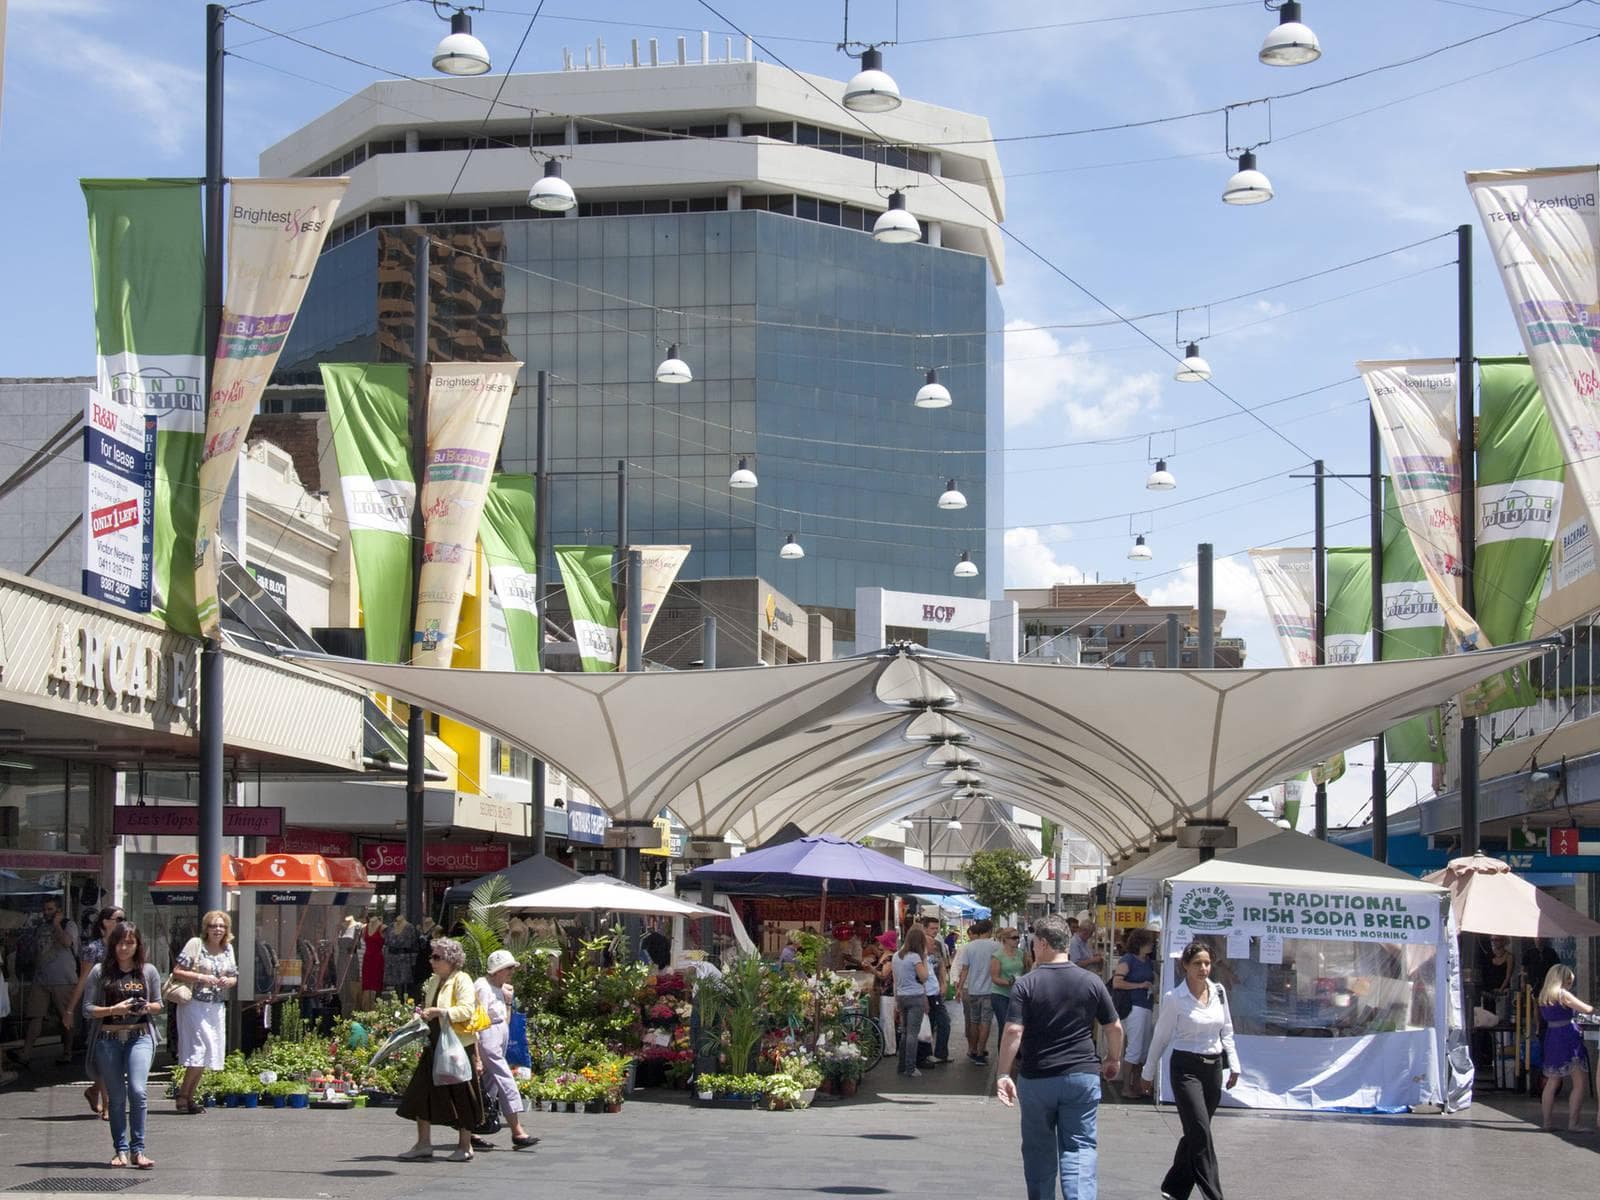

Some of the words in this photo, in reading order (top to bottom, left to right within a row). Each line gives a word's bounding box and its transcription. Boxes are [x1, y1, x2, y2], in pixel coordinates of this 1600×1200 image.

[233, 206, 291, 224] Brightest
[301, 220, 325, 232] BES
[112, 376, 200, 394] BONDI
[435, 377, 480, 391] Brightest
[93, 403, 118, 432] R&W
[100, 438, 112, 458] for
[113, 444, 135, 469] lease
[142, 434, 153, 526] RICHARDSON
[93, 514, 113, 532] ONLY
[112, 508, 120, 528] 1
[119, 507, 138, 523] LEFT
[96, 540, 113, 555] Victor
[140, 553, 151, 608] WRENCH
[269, 580, 285, 595] BLOCK
[922, 604, 955, 622] HCF
[51, 622, 187, 708] ARCADE
[127, 811, 160, 825] Liz's
[163, 811, 193, 830] Tops
[227, 811, 270, 830] Things
[1560, 831, 1568, 855] TAX
[426, 851, 479, 869] beauty
[1178, 888, 1196, 914] PADDY
[1268, 892, 1407, 912] TRADITIONAL
[1243, 907, 1294, 923] IRISH
[1301, 910, 1356, 927] SODA
[1364, 914, 1431, 930] BREAD
[1266, 926, 1299, 934] BAKED
[1301, 927, 1332, 937] FRESH
[1335, 929, 1358, 937] THIS
[1360, 931, 1408, 940] MORNING
